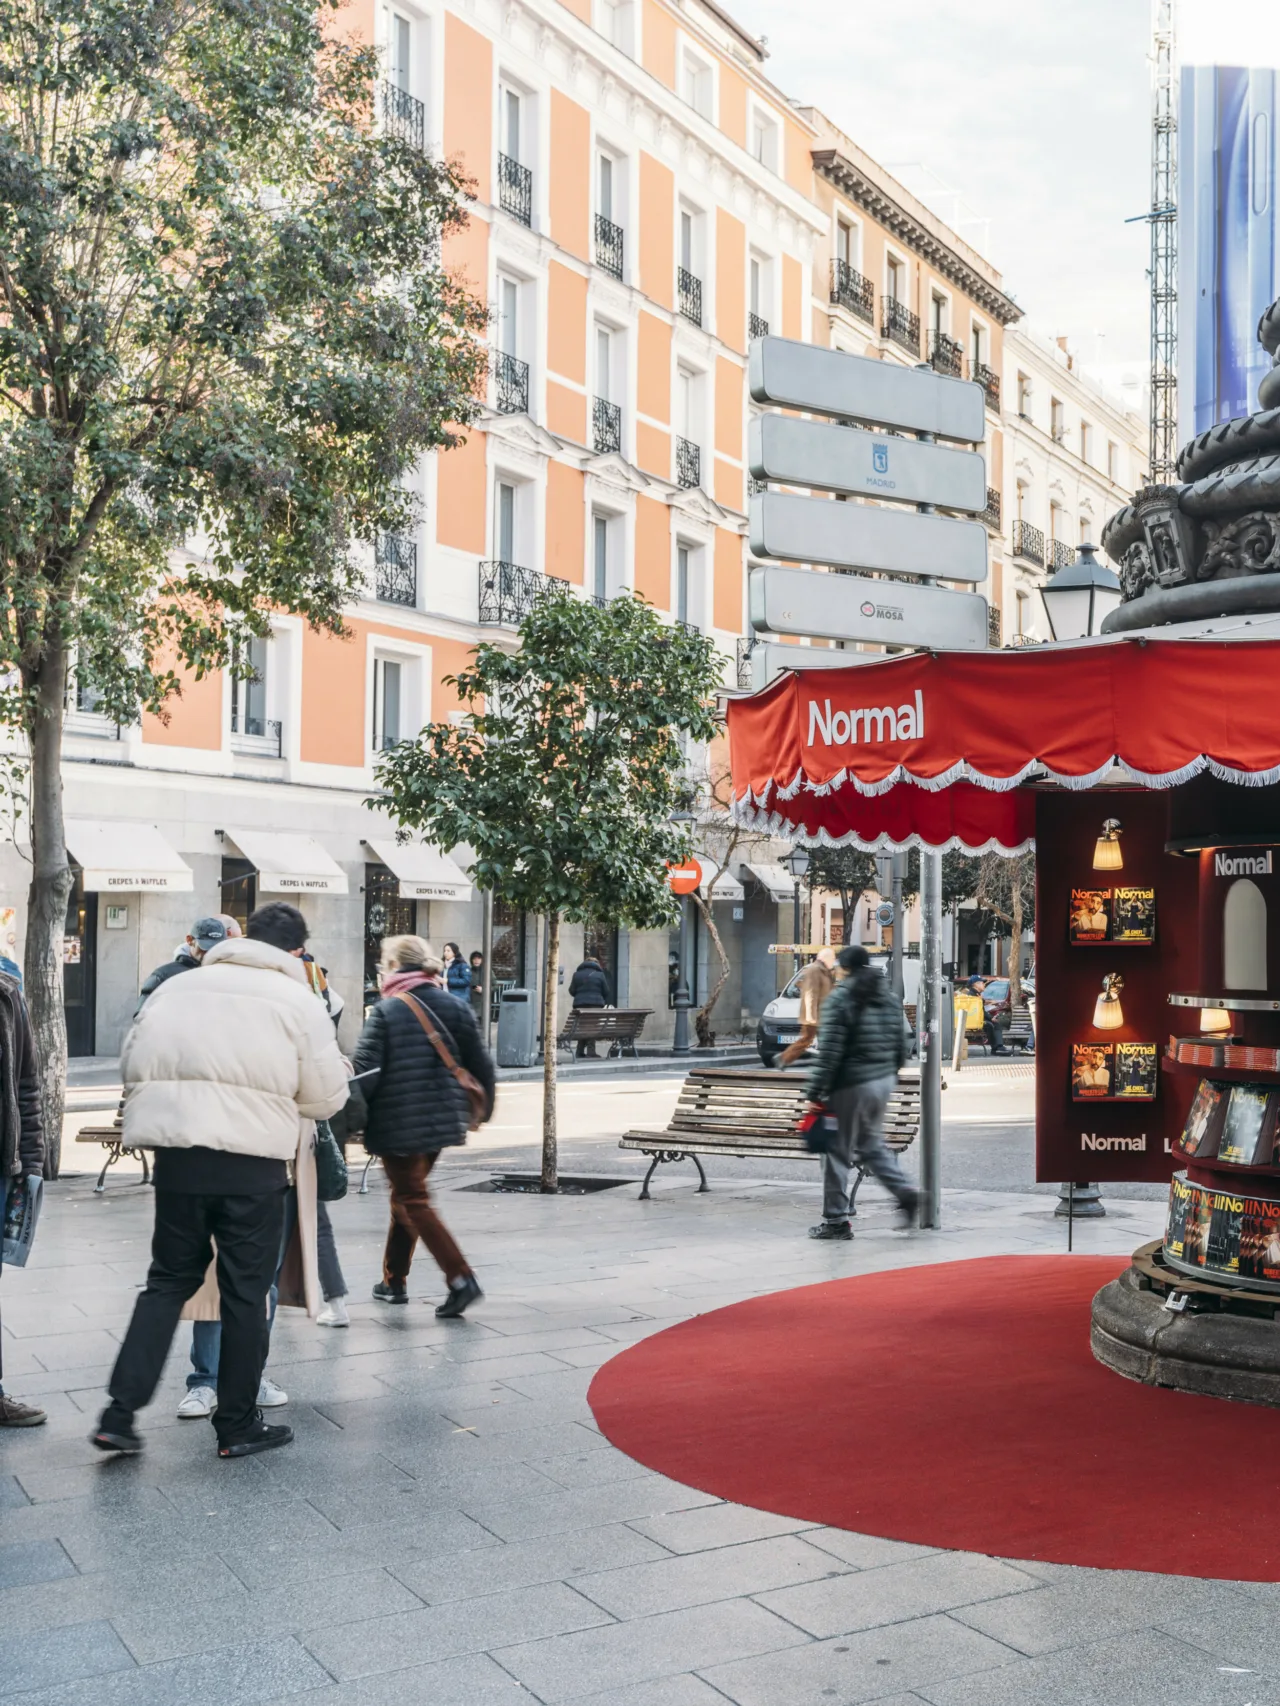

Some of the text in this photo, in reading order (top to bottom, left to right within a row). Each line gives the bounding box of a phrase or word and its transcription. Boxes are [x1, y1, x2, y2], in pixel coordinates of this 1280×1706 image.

[866, 477, 896, 489] MADRID
[876, 609, 904, 621] MOSA
[807, 689, 925, 747] Normal
[1215, 850, 1272, 877] Normal
[1115, 888, 1154, 899] Normal
[1116, 1043, 1156, 1055] Normal
[1081, 1133, 1146, 1151] Normal
